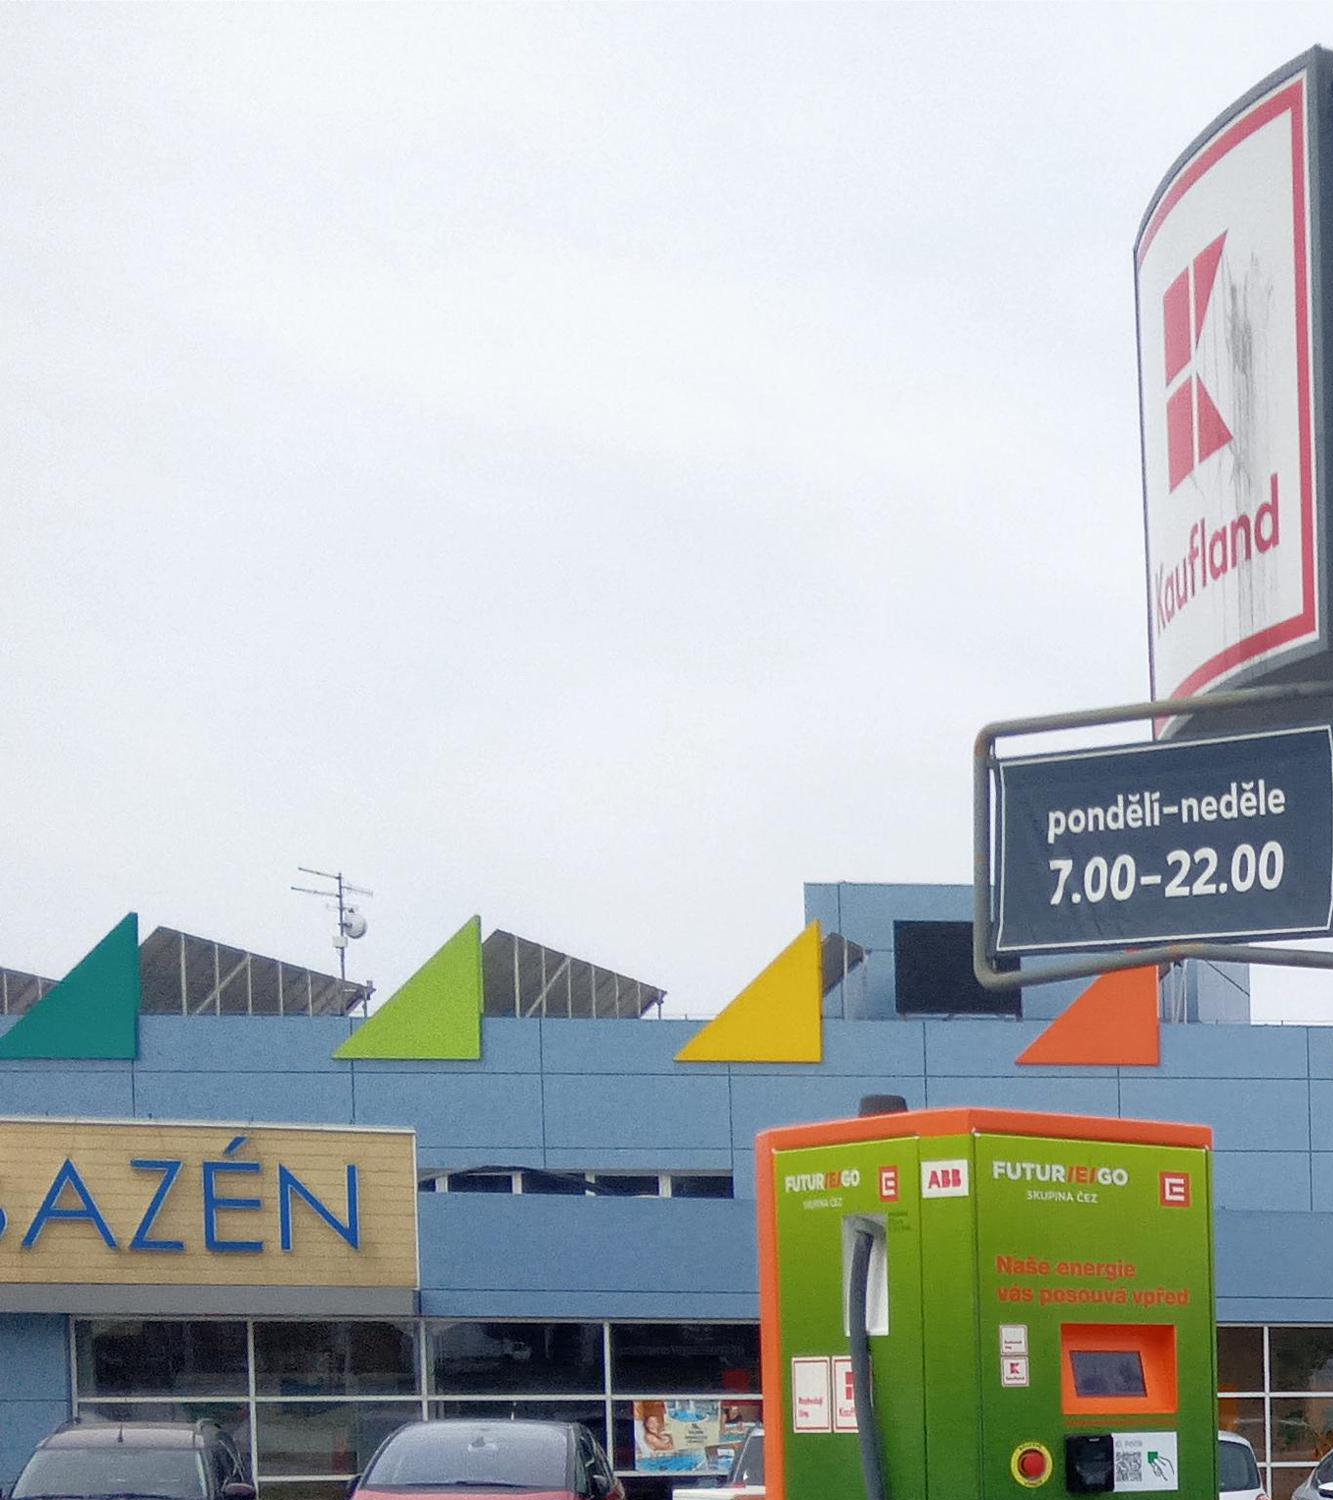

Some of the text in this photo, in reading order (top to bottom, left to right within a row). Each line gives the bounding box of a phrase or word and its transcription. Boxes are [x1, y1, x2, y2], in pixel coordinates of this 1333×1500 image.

[1155, 471, 1279, 640] Kaufland
[1048, 778, 1286, 844] pondělí-neděle
[1049, 841, 1285, 905] 7.00-22.00
[928, 1168, 962, 1189] ABB
[992, 1161, 1129, 1186] FUTUR/E/GO
[0, 1136, 360, 1252] AZÉN
[1027, 1190, 1098, 1204] SKUPINA ČEZ
[996, 1255, 1136, 1281] Naše energie
[998, 1284, 1190, 1308] vás posouvá vpřed
